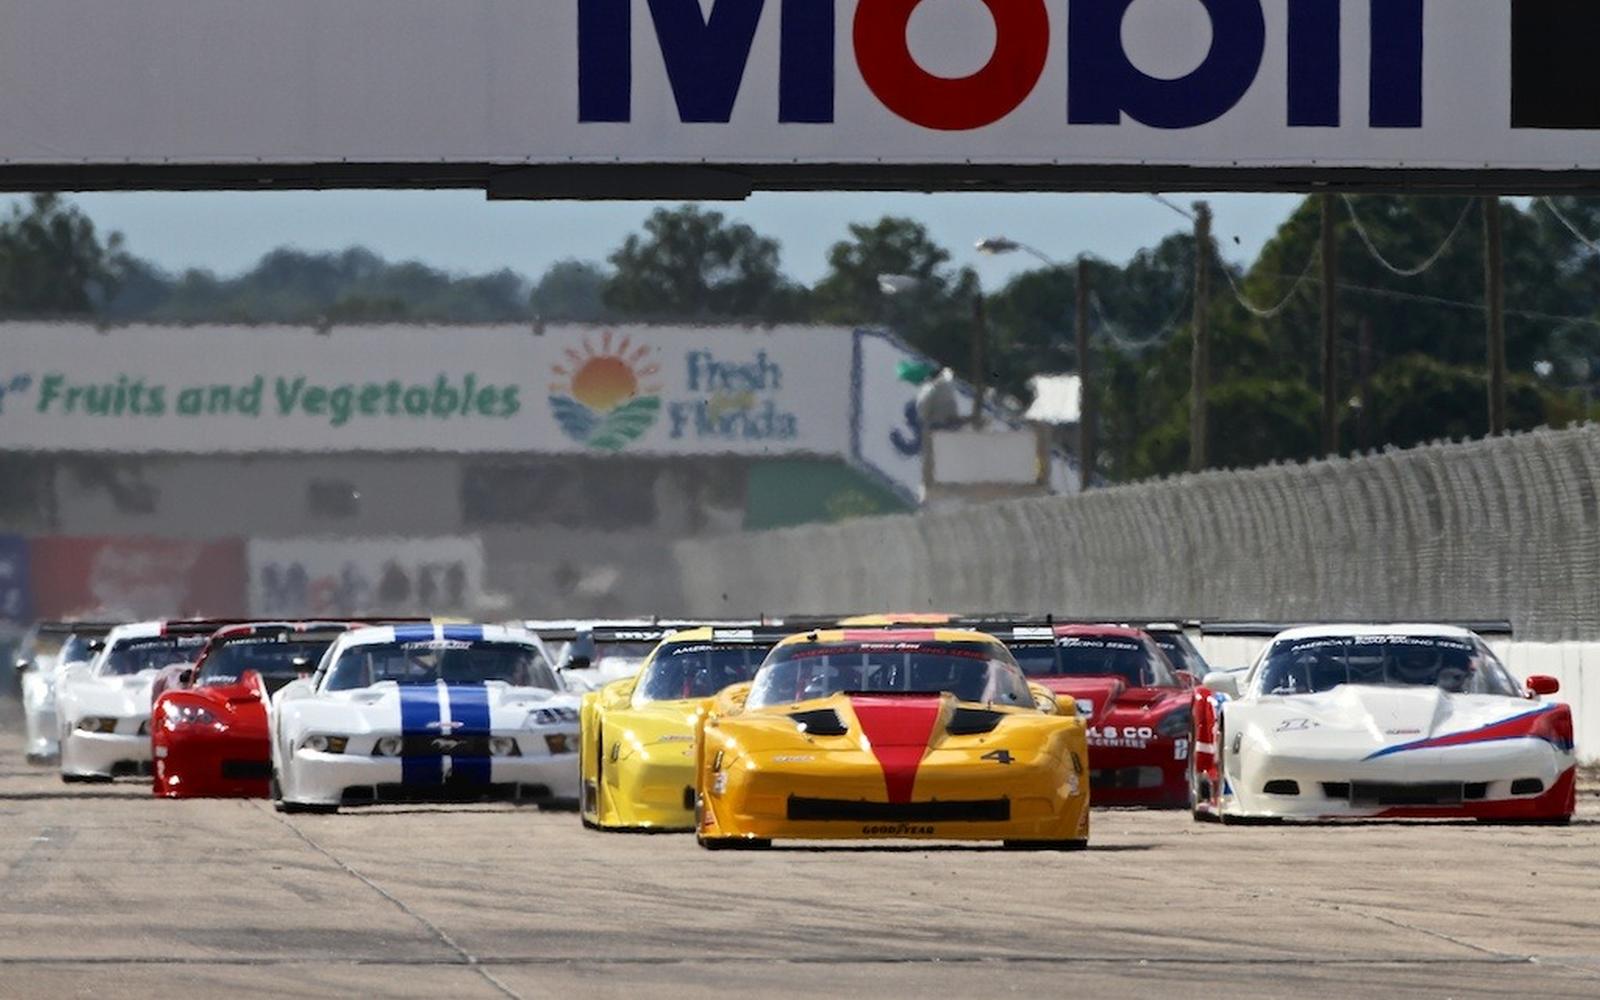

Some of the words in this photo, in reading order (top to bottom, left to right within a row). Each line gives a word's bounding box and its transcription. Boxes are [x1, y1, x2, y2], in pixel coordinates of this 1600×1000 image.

[687, 350, 781, 392] Fresh
[36, 373, 166, 416] Fruits
[175, 374, 265, 417] and
[275, 373, 520, 427] Vegetables
[669, 399, 798, 440] Florida
[980, 750, 1016, 764] 4
[862, 826, 935, 836] GOODYEAR
